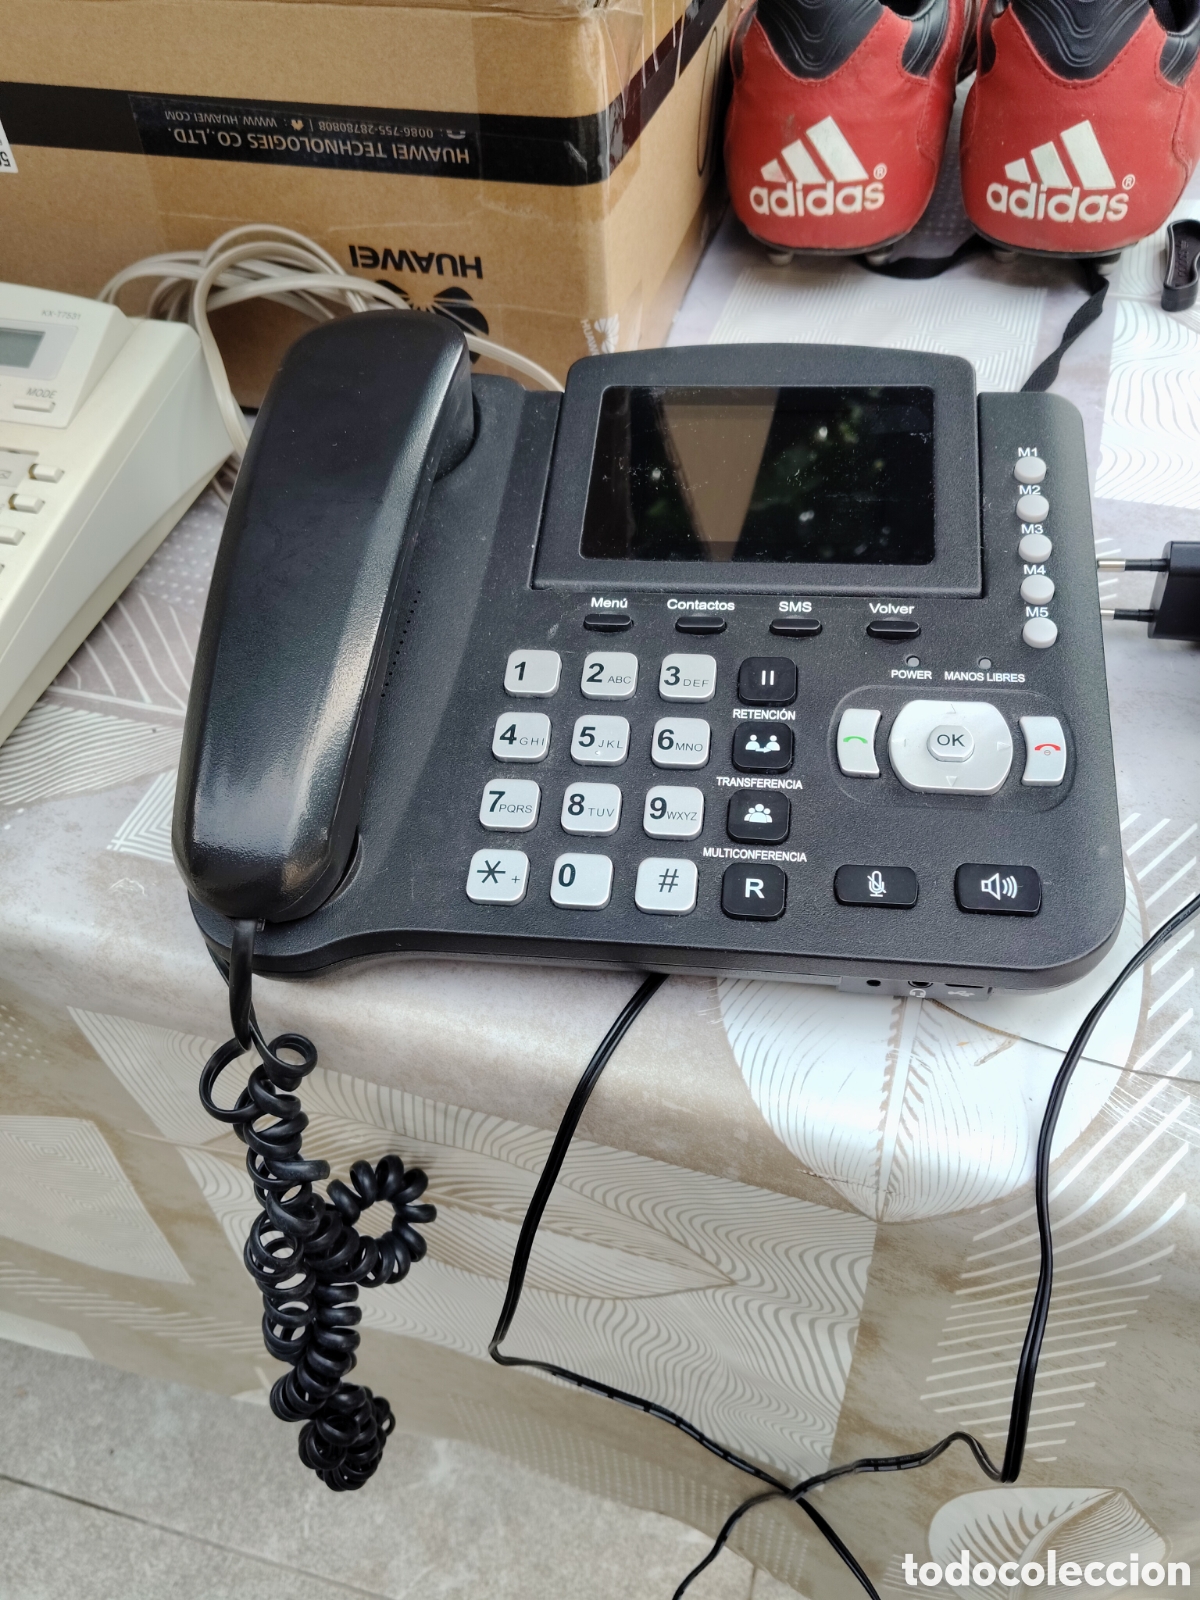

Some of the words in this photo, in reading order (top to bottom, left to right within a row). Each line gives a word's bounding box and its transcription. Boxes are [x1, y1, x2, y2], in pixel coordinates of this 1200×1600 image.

[165, 110, 278, 128] WWW.HUAWEI.COM
[319, 121, 433, 138] 0086-755-28780808
[249, 135, 387, 158] TECHNOLOGIES
[393, 143, 470, 164] HUAWEI
[749, 180, 885, 217] adidas
[986, 181, 1129, 223] adidas
[348, 244, 484, 280] HUAWEI
[41, 310, 82, 320] KX-T7531
[26, 388, 58, 399] MODE
[1017, 447, 1038, 457] M1
[1019, 485, 1041, 495] M2
[1021, 524, 1044, 534] M3
[1023, 565, 1046, 575] M4
[590, 597, 628, 609] Menú
[666, 598, 735, 611] Contactos
[778, 601, 812, 613] SMS
[869, 602, 915, 616] Volver
[1025, 607, 1049, 618] M5
[514, 661, 527, 681] 1
[586, 663, 605, 683] 2
[607, 675, 632, 685] ABC
[663, 665, 681, 686] 3
[683, 679, 709, 688] DEF
[891, 669, 932, 680] POWER
[944, 671, 985, 682] MANOS
[987, 672, 1025, 683] LIBRES
[732, 707, 796, 721] RETENCIÓN
[499, 724, 517, 745] 4
[519, 736, 545, 747] GHI
[578, 726, 596, 748] 5
[598, 738, 623, 749] JKL
[657, 729, 675, 751] 6
[675, 742, 703, 752] MNO
[936, 733, 966, 748] OK
[716, 776, 803, 790] TRANSFERENCIA
[488, 790, 506, 812] 7
[499, 803, 533, 814] PQRS
[567, 793, 585, 816] 8
[588, 807, 615, 817] TUV
[649, 796, 668, 820] 9
[666, 810, 697, 821] WXYZ
[702, 847, 807, 862] MULTICONFERENCIA
[558, 863, 576, 887] 0
[658, 868, 680, 893] #
[744, 878, 765, 899] R
